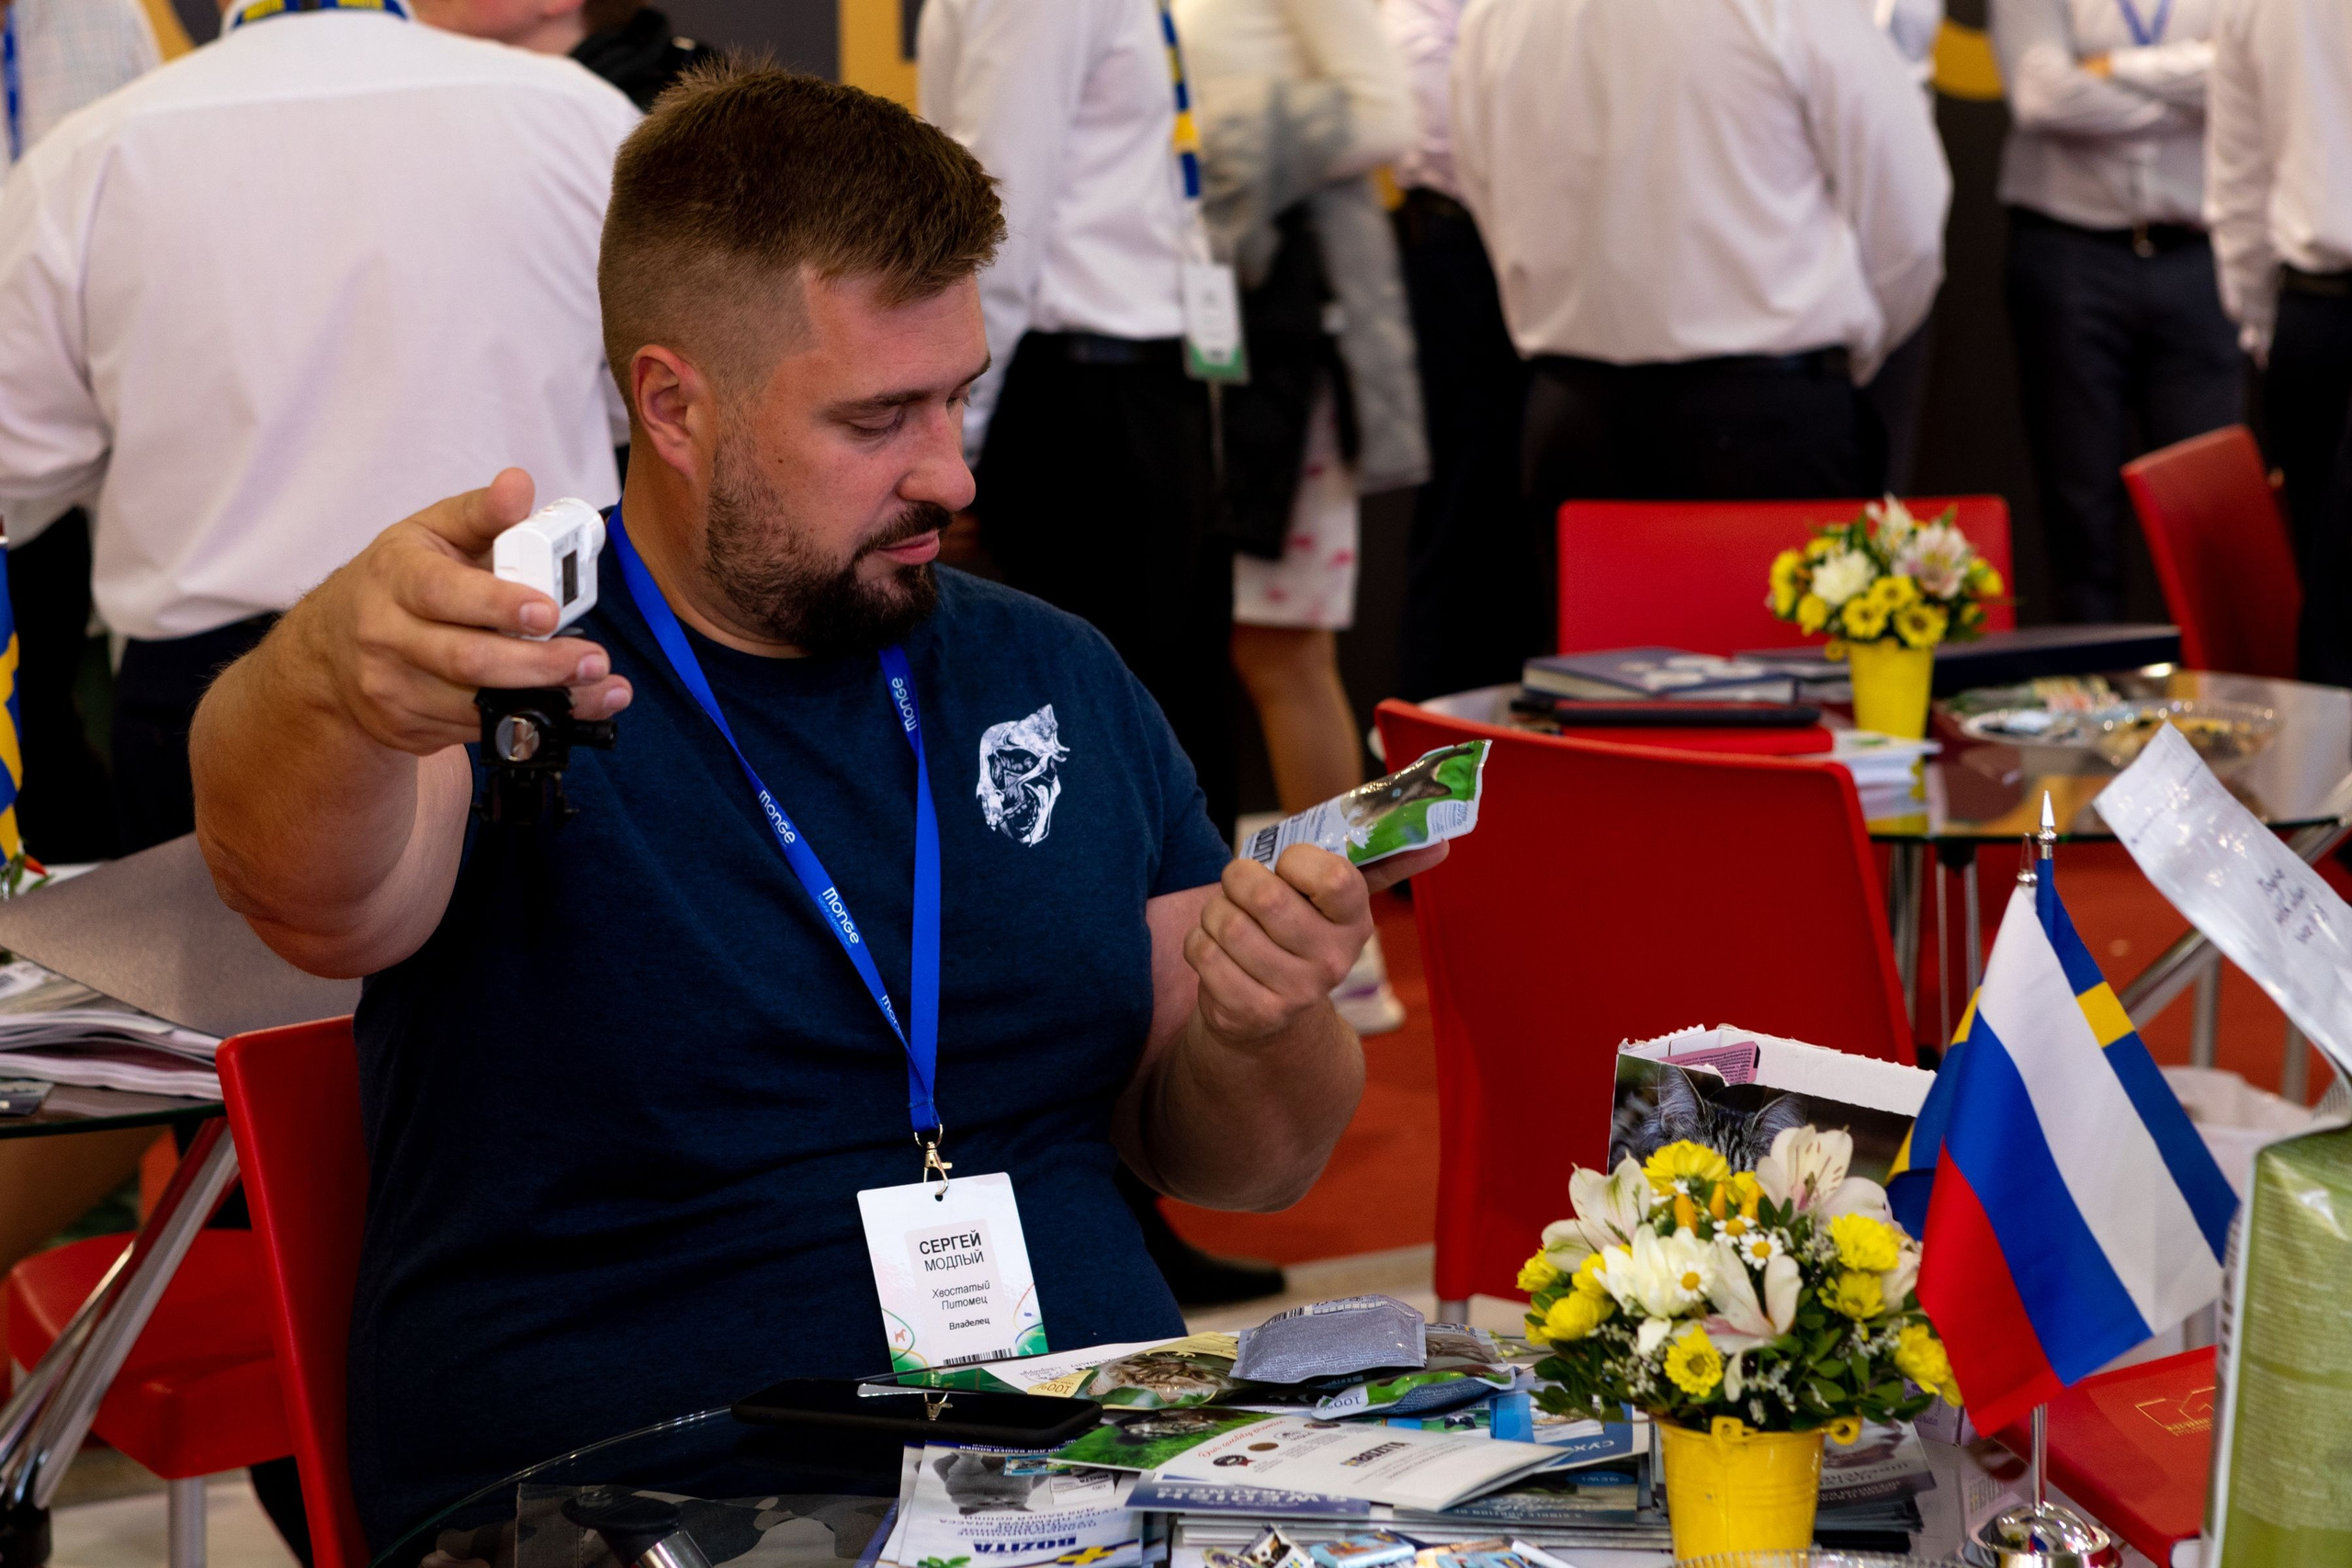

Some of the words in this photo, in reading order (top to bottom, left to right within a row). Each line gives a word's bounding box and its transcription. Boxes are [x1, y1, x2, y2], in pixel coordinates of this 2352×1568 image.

[919, 1229, 982, 1255] СЕРГЕЙ
[924, 1249, 984, 1271] МОДЛЫЙ
[932, 1280, 990, 1299] Хвостатый
[942, 1295, 988, 1311] Питомец
[948, 1316, 990, 1331] Владелец
[974, 1536, 1077, 1553] BOZITA
